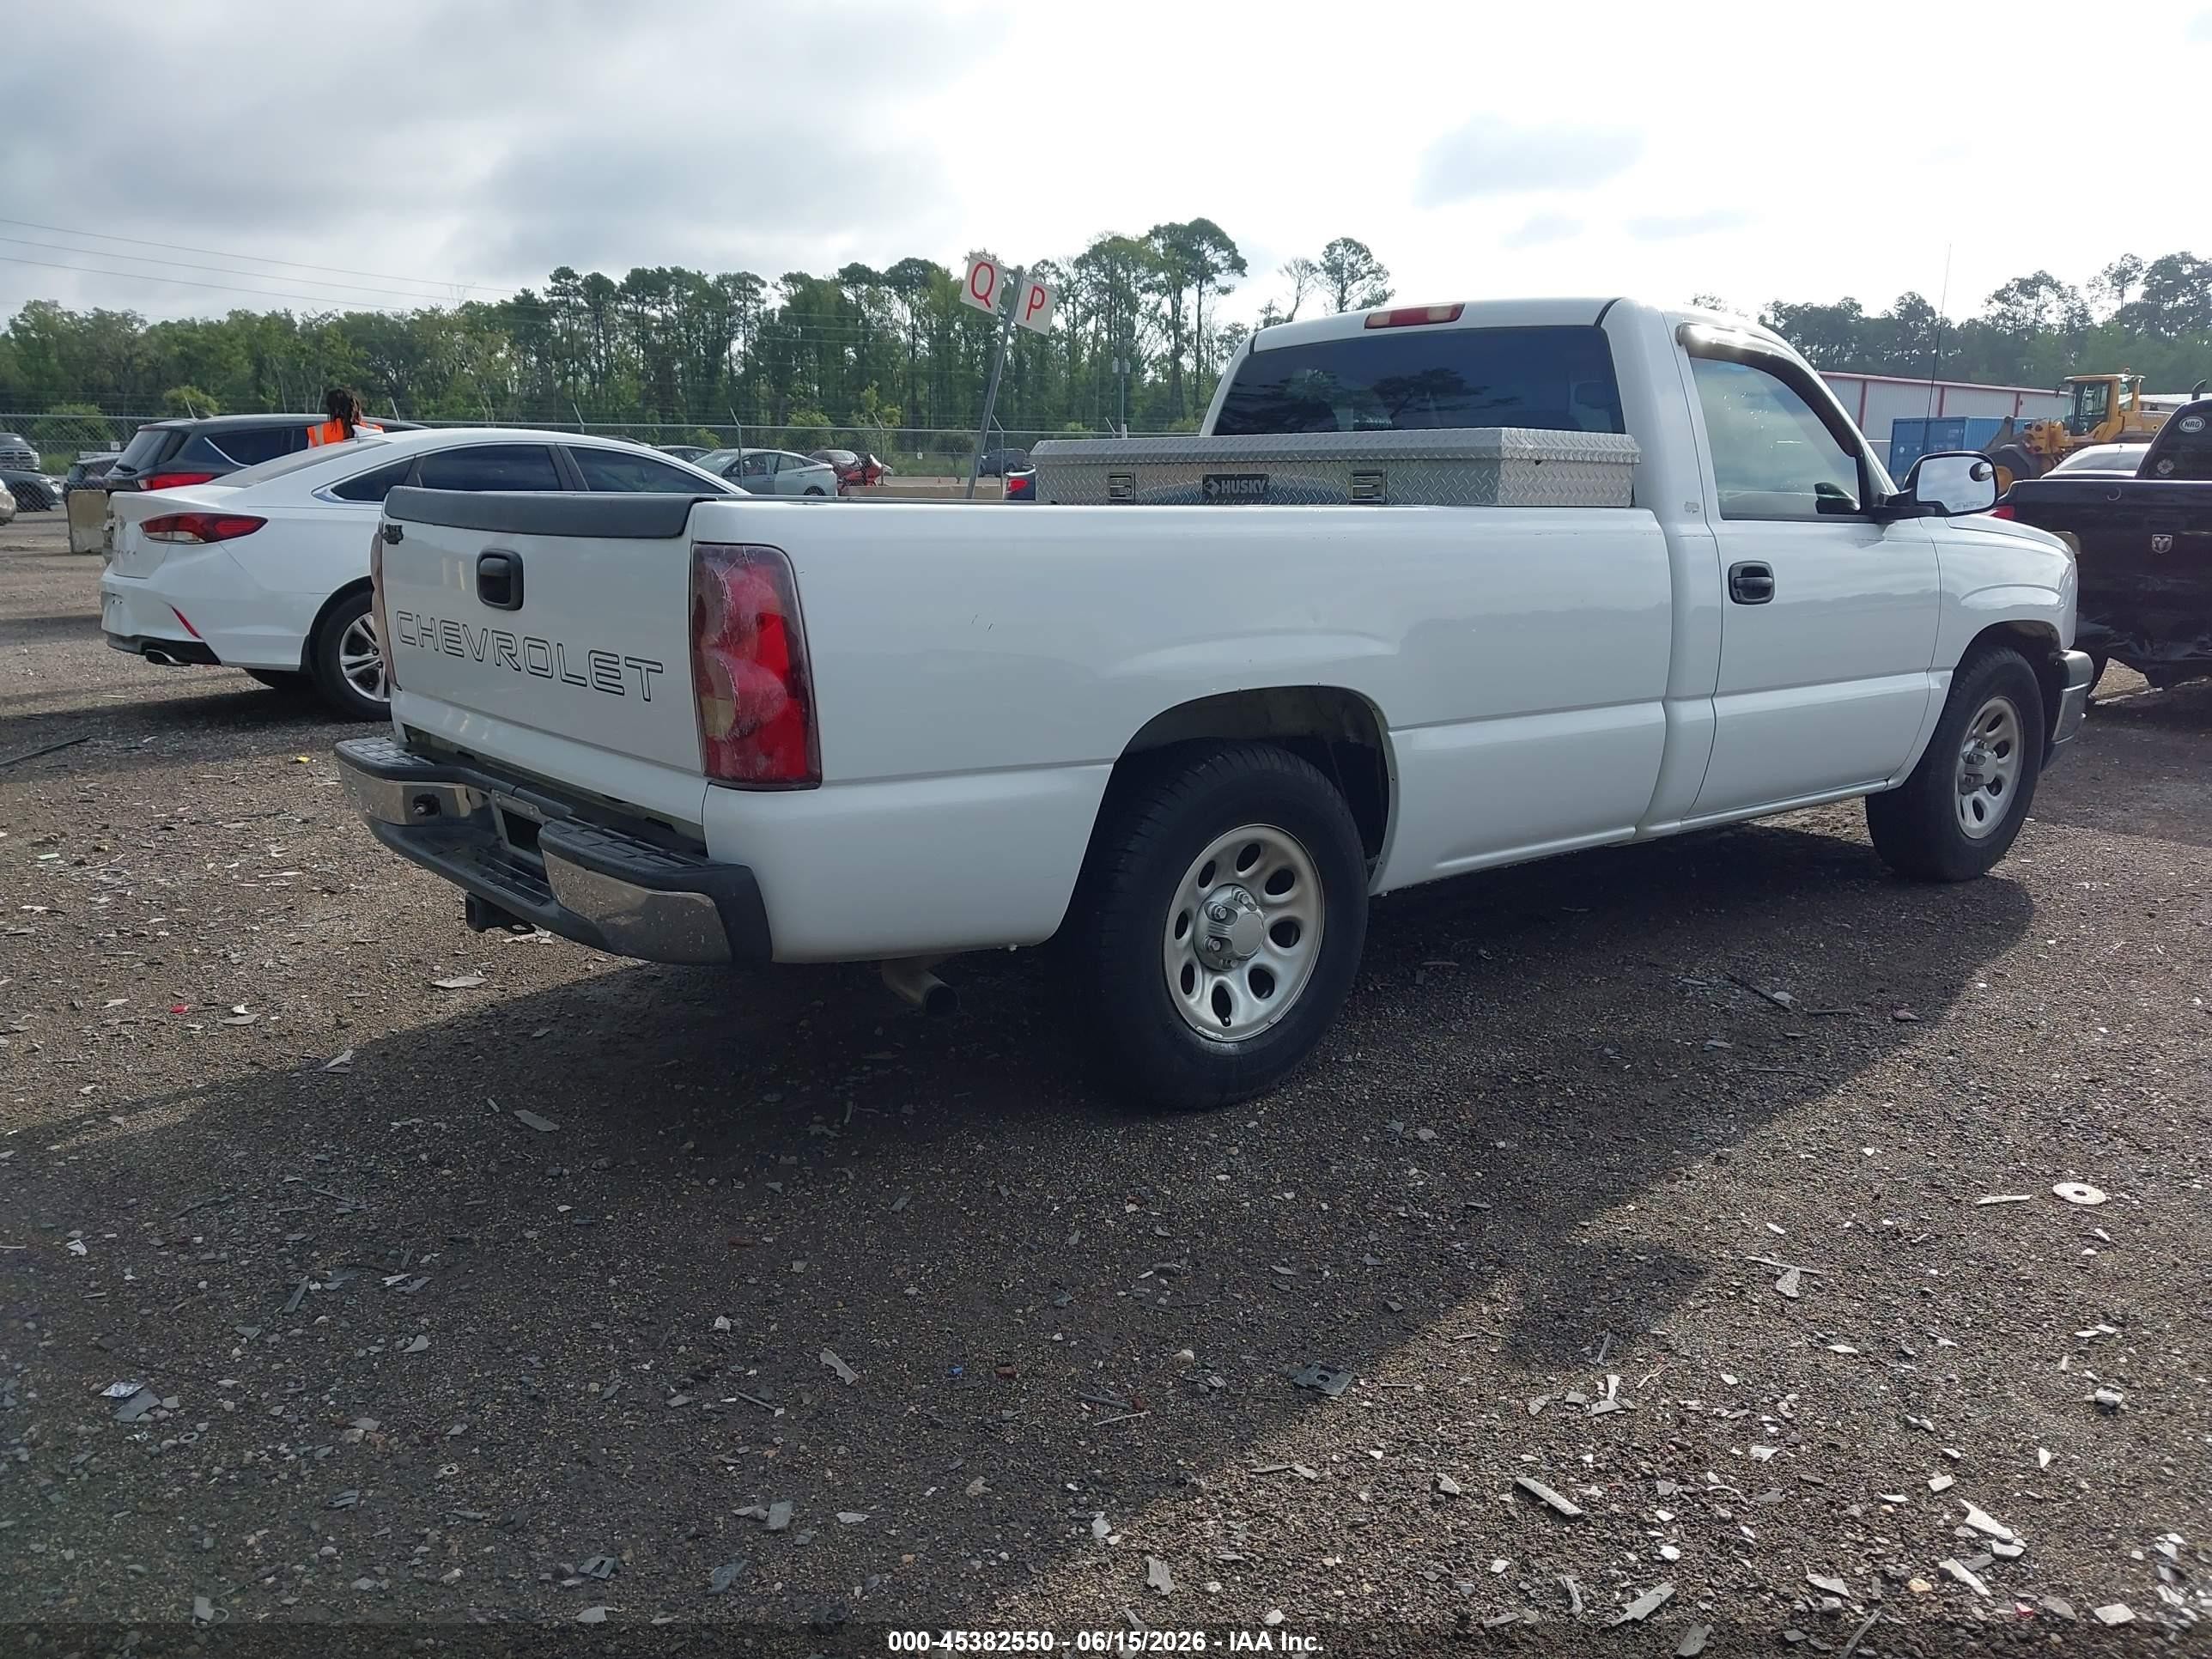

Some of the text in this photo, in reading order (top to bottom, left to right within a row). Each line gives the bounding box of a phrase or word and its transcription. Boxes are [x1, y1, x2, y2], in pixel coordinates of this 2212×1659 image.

[970, 261, 994, 308] Q
[1025, 285, 1046, 321] P
[1221, 479, 1267, 494] HUSKY
[397, 611, 664, 702] CHEVROLET
